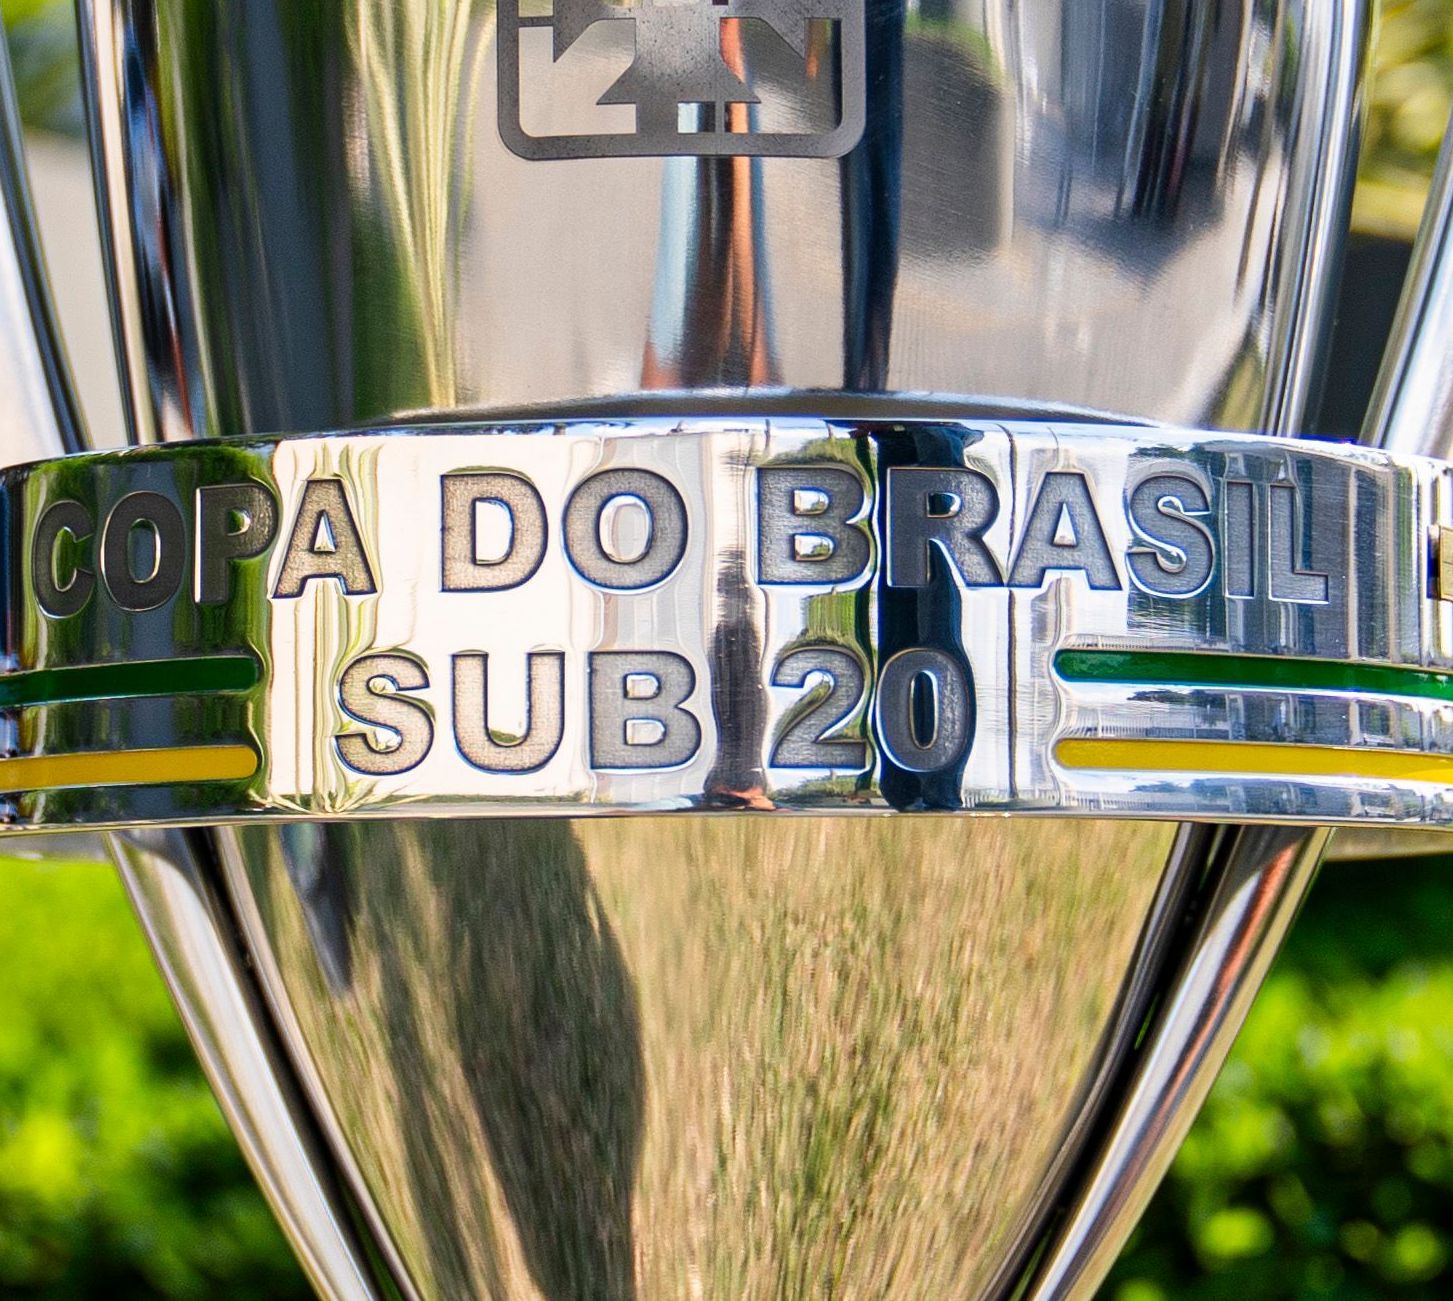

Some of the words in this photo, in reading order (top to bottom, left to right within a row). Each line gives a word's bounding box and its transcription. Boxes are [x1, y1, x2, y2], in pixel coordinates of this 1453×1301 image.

[31, 476, 379, 619] COPA
[438, 467, 690, 593] DO
[756, 464, 1331, 604] BRASIL
[333, 649, 703, 776] SUB
[769, 646, 975, 773] 20
